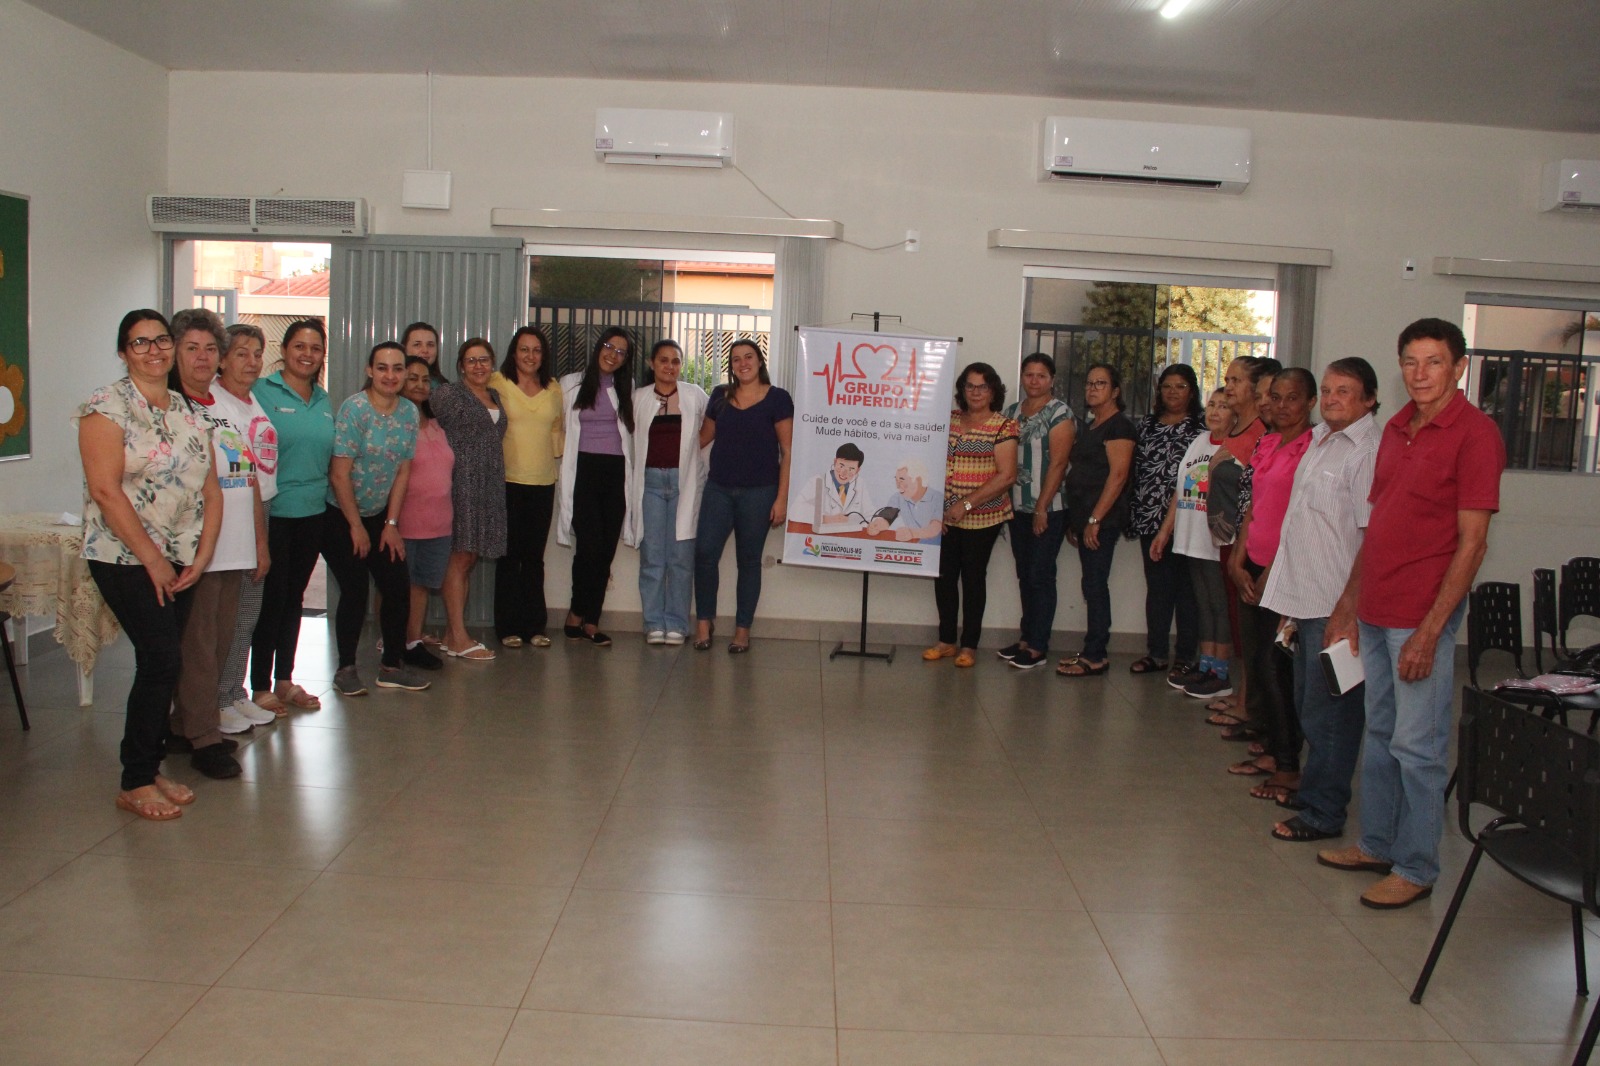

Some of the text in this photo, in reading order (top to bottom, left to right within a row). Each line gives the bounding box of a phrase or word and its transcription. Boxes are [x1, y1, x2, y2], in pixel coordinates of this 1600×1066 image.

[844, 382, 903, 396] GRUPO
[836, 394, 909, 409] HIPERDIA
[801, 413, 829, 425] Cuide
[831, 415, 844, 425] de
[846, 418, 868, 427] você
[879, 420, 892, 429] da
[894, 422, 911, 430] sua
[913, 423, 946, 433] saúde!
[815, 426, 931, 443] Mude hábitos, viva mais!
[875, 553, 921, 563] SAÚDE
